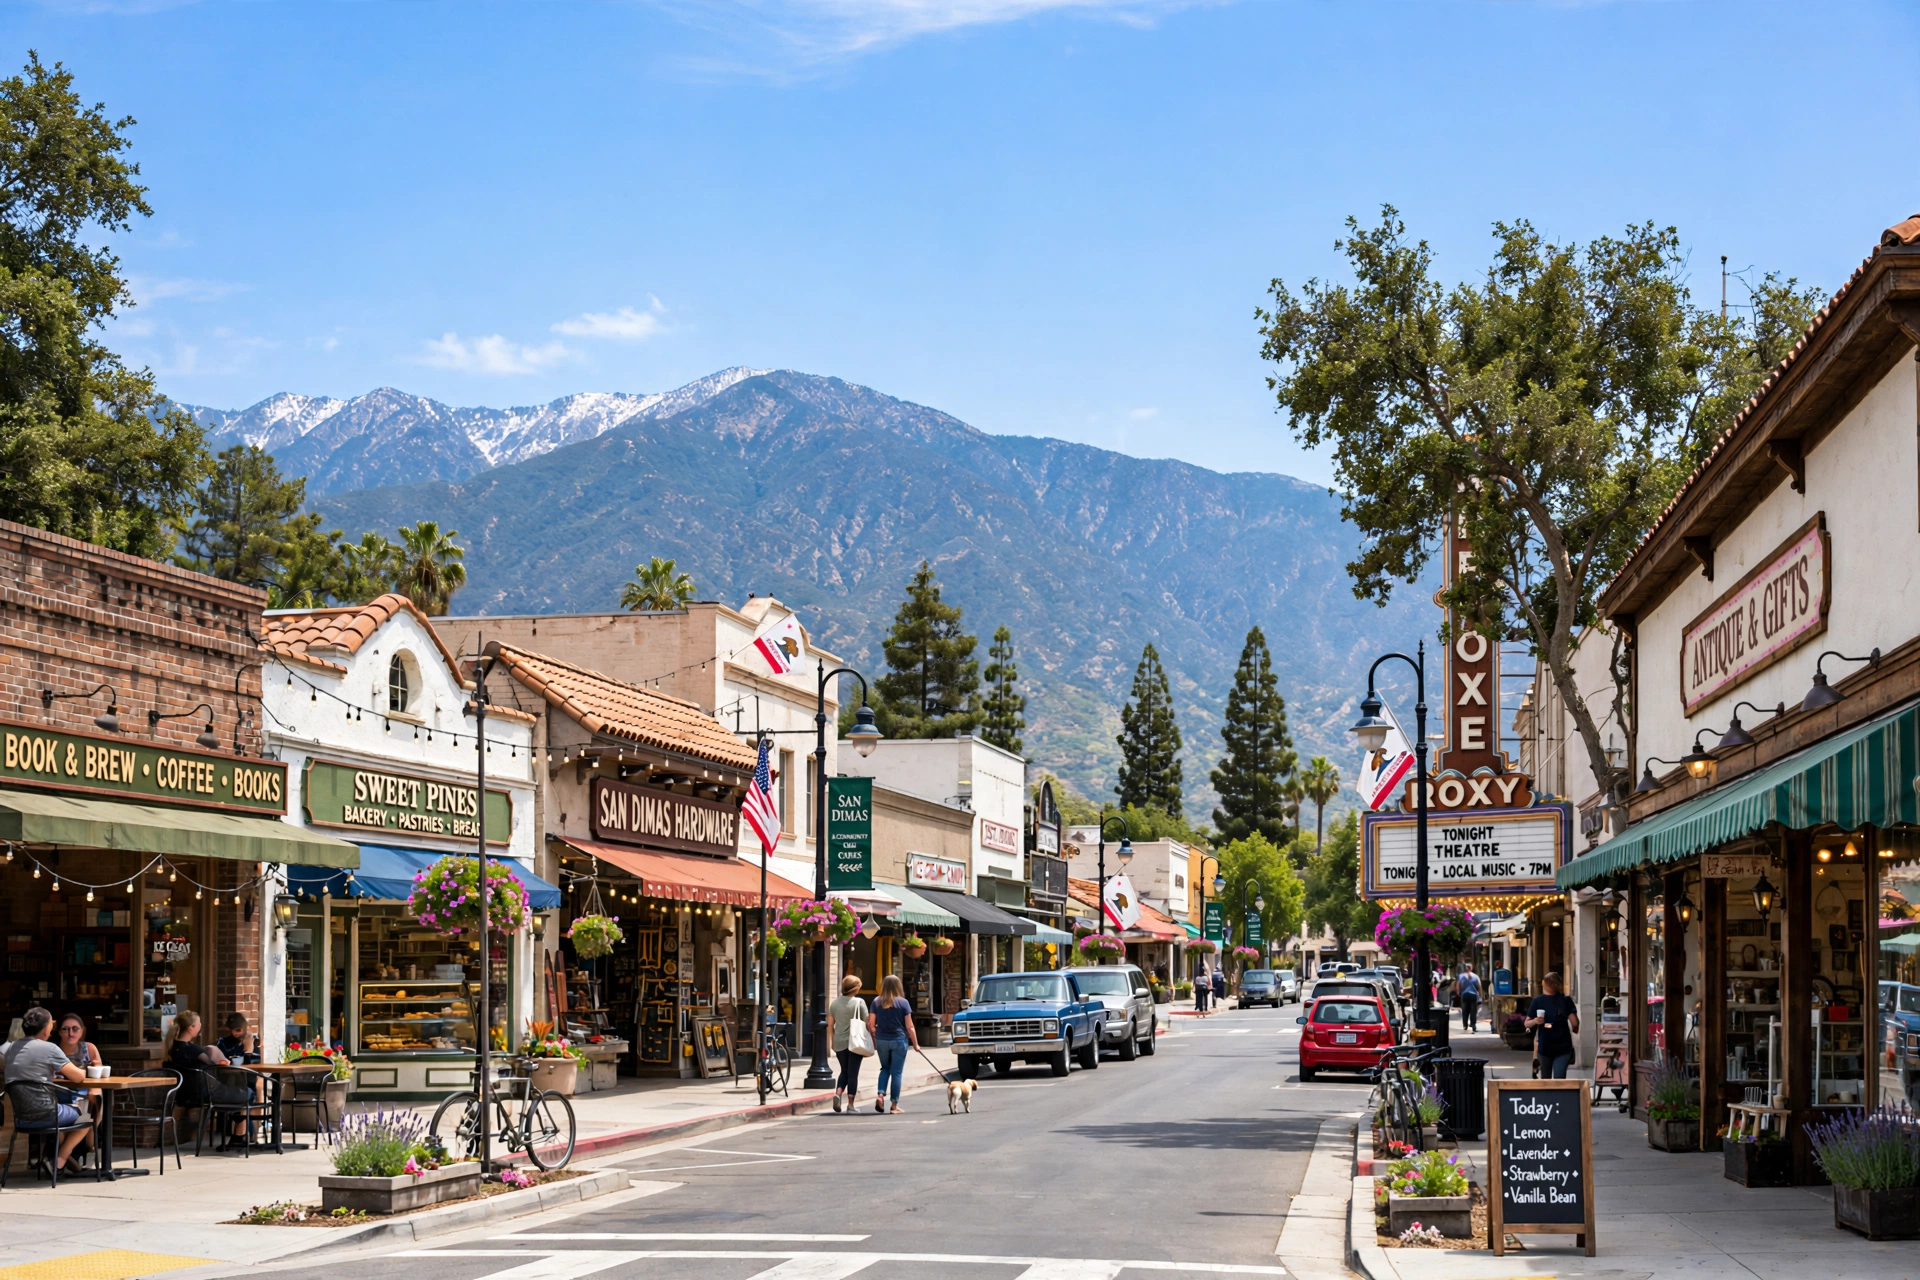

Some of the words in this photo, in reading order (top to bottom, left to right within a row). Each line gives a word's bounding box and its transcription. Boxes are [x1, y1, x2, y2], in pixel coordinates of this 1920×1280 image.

[1692, 606, 1744, 689] ANTIQUE
[1748, 597, 1758, 650] &
[1762, 554, 1809, 640] GIFTS
[5, 732, 58, 774] BOOK
[65, 742, 78, 776] &
[85, 745, 136, 784] BREW
[156, 756, 215, 794] COFFEE
[233, 767, 280, 803] BOOKS
[354, 771, 421, 809] SWEET
[426, 782, 478, 818] PINES
[838, 794, 862, 808] SAN
[1411, 777, 1520, 809] ROXY
[344, 804, 388, 827] BAKERY
[398, 814, 444, 834] PASTRIES
[600, 787, 628, 831] SAN
[632, 794, 671, 840] DIMAS
[675, 803, 734, 848] HARDWARE
[831, 809, 868, 822] DIMAS
[1442, 826, 1495, 842] TONIGHT
[1434, 842, 1500, 859] THEATRE
[1383, 865, 1430, 880] TONIG
[1443, 863, 1477, 879] LOCAL
[1481, 862, 1516, 877] MUSIC
[1529, 861, 1552, 876] 7PM
[1513, 1123, 1551, 1139] Lemon
[1509, 1143, 1560, 1160] Lavender
[1509, 1165, 1569, 1186] Strawberry
[1510, 1186, 1547, 1204] Vanilla
[1549, 1187, 1577, 1203] Bean
